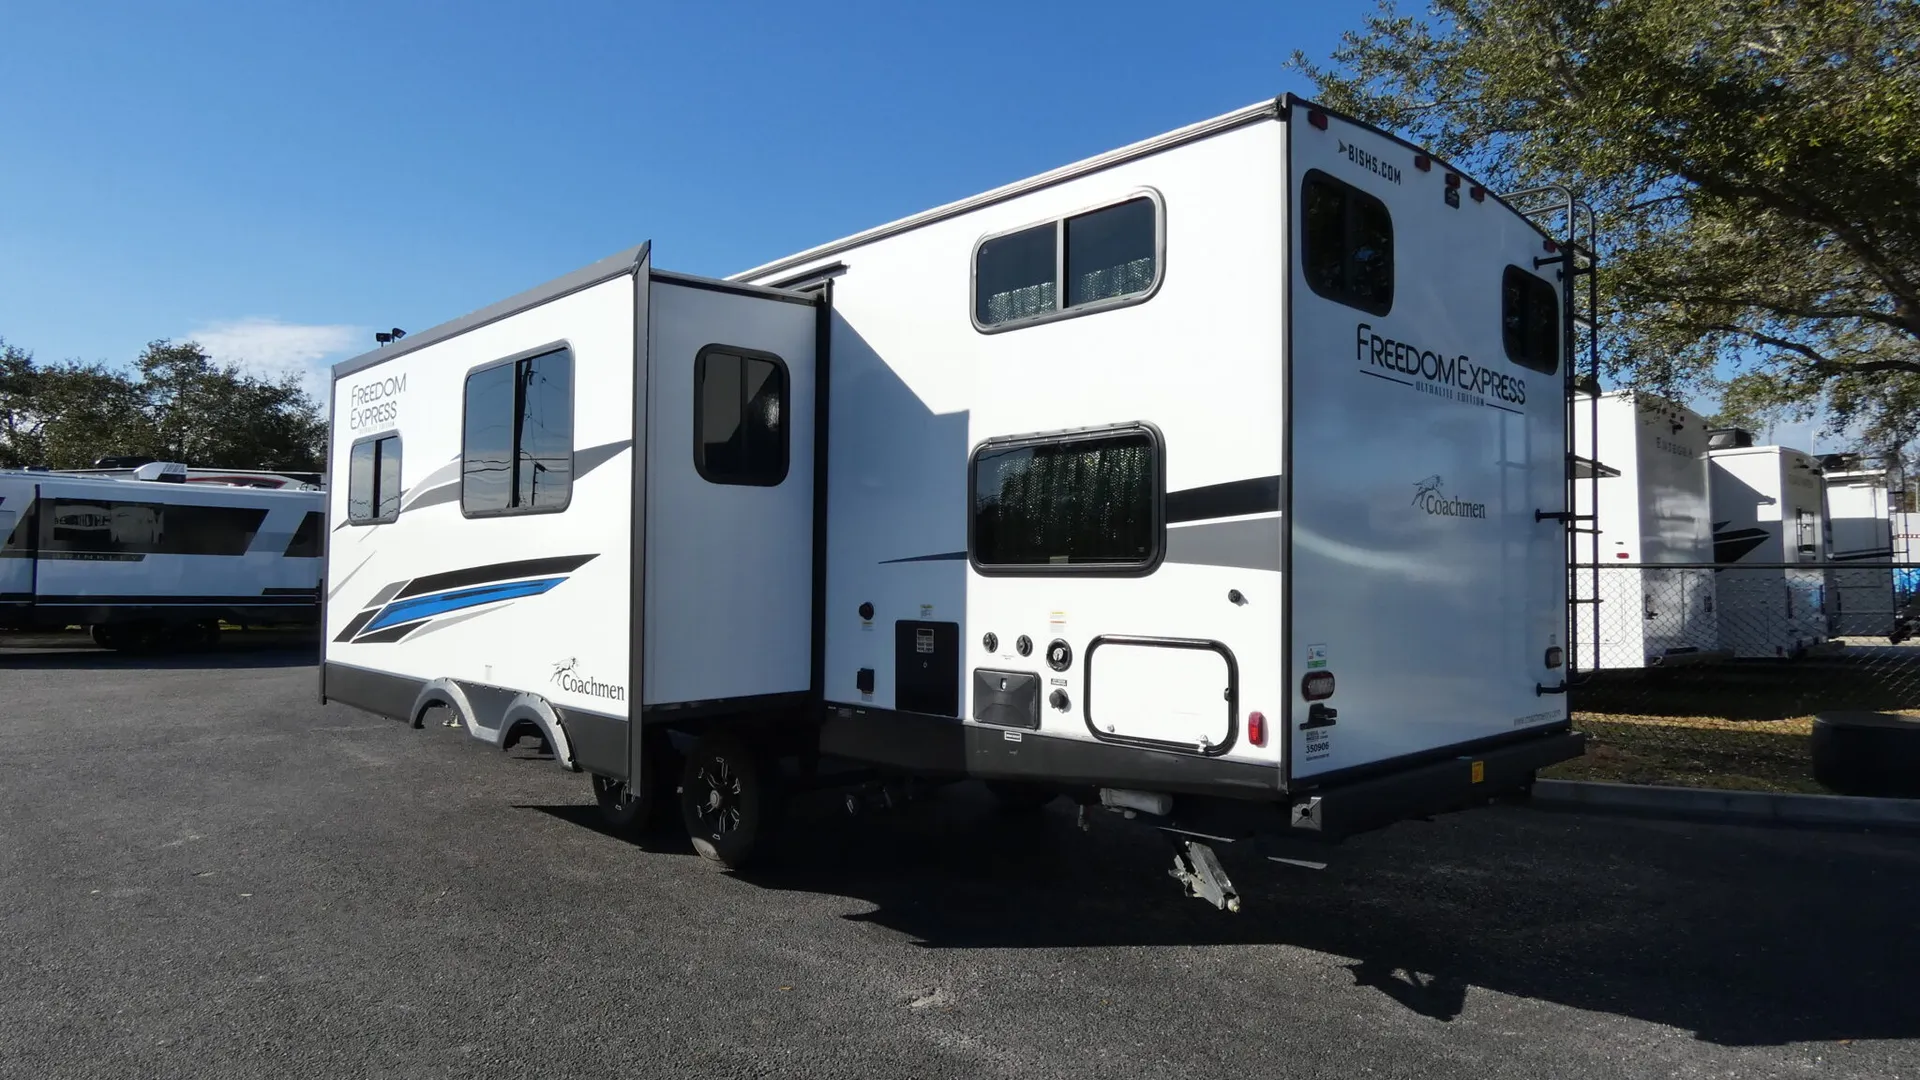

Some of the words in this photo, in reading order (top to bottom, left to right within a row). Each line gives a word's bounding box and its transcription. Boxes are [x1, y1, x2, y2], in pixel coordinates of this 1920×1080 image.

[1348, 143, 1402, 187] BISHS.COM
[1357, 323, 1455, 387] FREEDOM
[1458, 355, 1526, 406] EXPRESS
[351, 372, 407, 408] FREEDOM
[350, 400, 398, 430] EXPRESS
[1426, 494, 1486, 519] Coachmen
[562, 676, 625, 701] Coachmen
[1306, 741, 1330, 755] 350906
